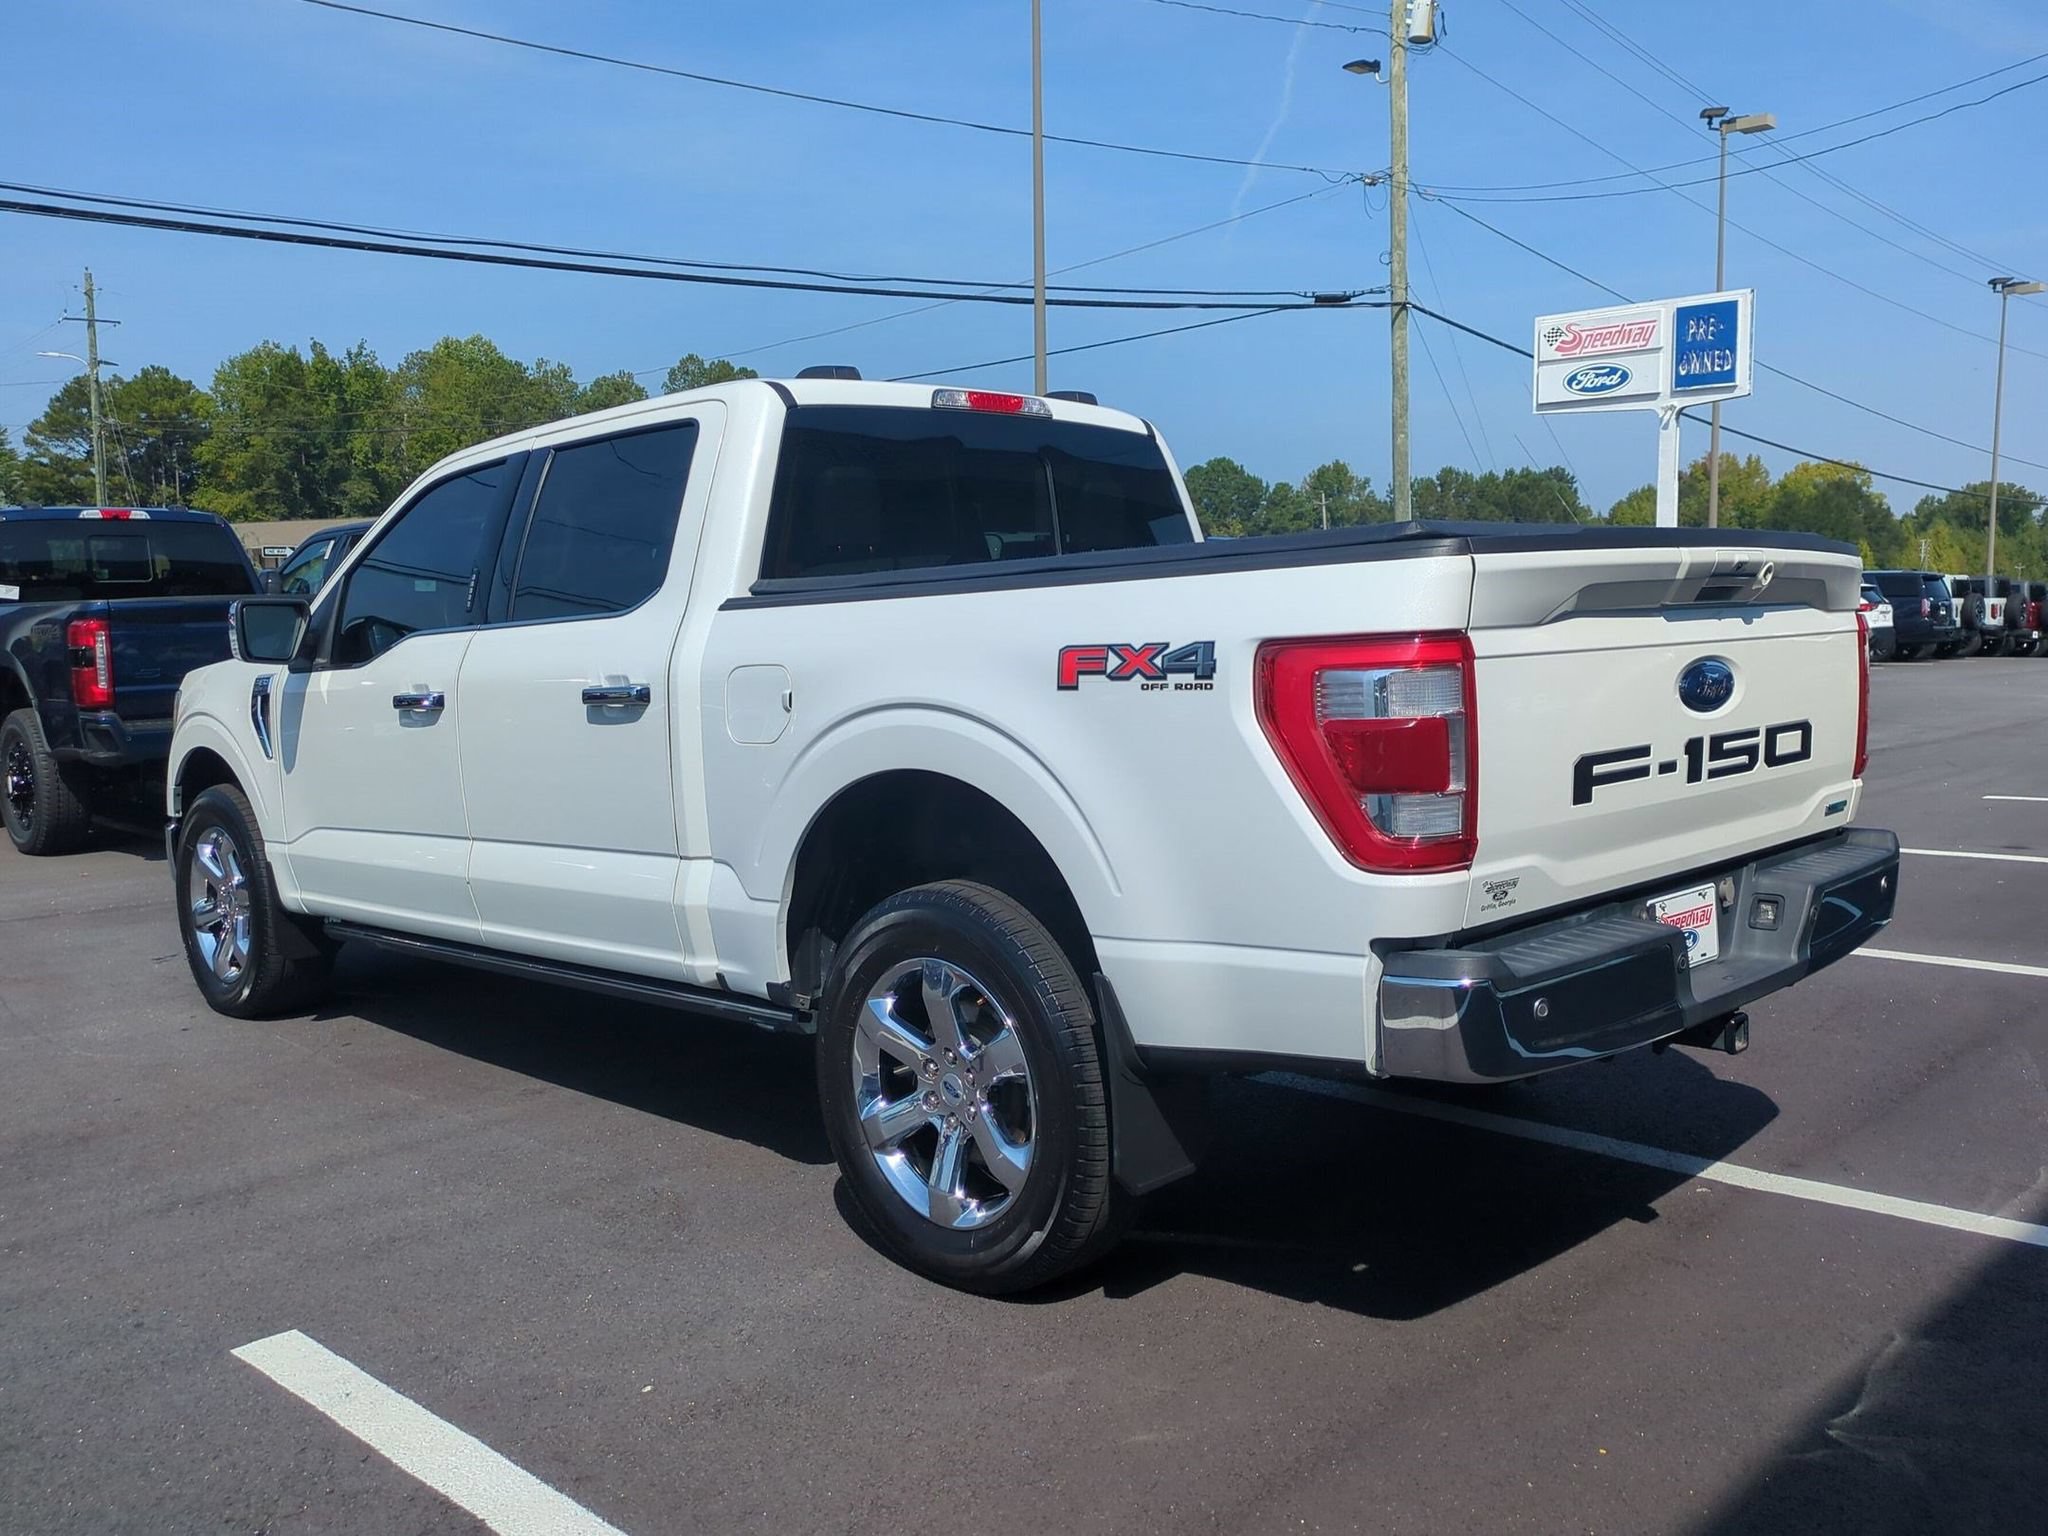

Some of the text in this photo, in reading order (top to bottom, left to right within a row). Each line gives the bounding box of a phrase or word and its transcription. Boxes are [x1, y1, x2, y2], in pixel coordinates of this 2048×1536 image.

[1555, 321, 1657, 355] Speedway
[1686, 316, 1725, 343] PRE-
[1678, 349, 1733, 376] OWNED
[1572, 368, 1623, 390] Ford
[1057, 640, 1217, 691] FX4
[1141, 682, 1214, 691] OFF ROAD
[1572, 719, 1813, 807] F-150
